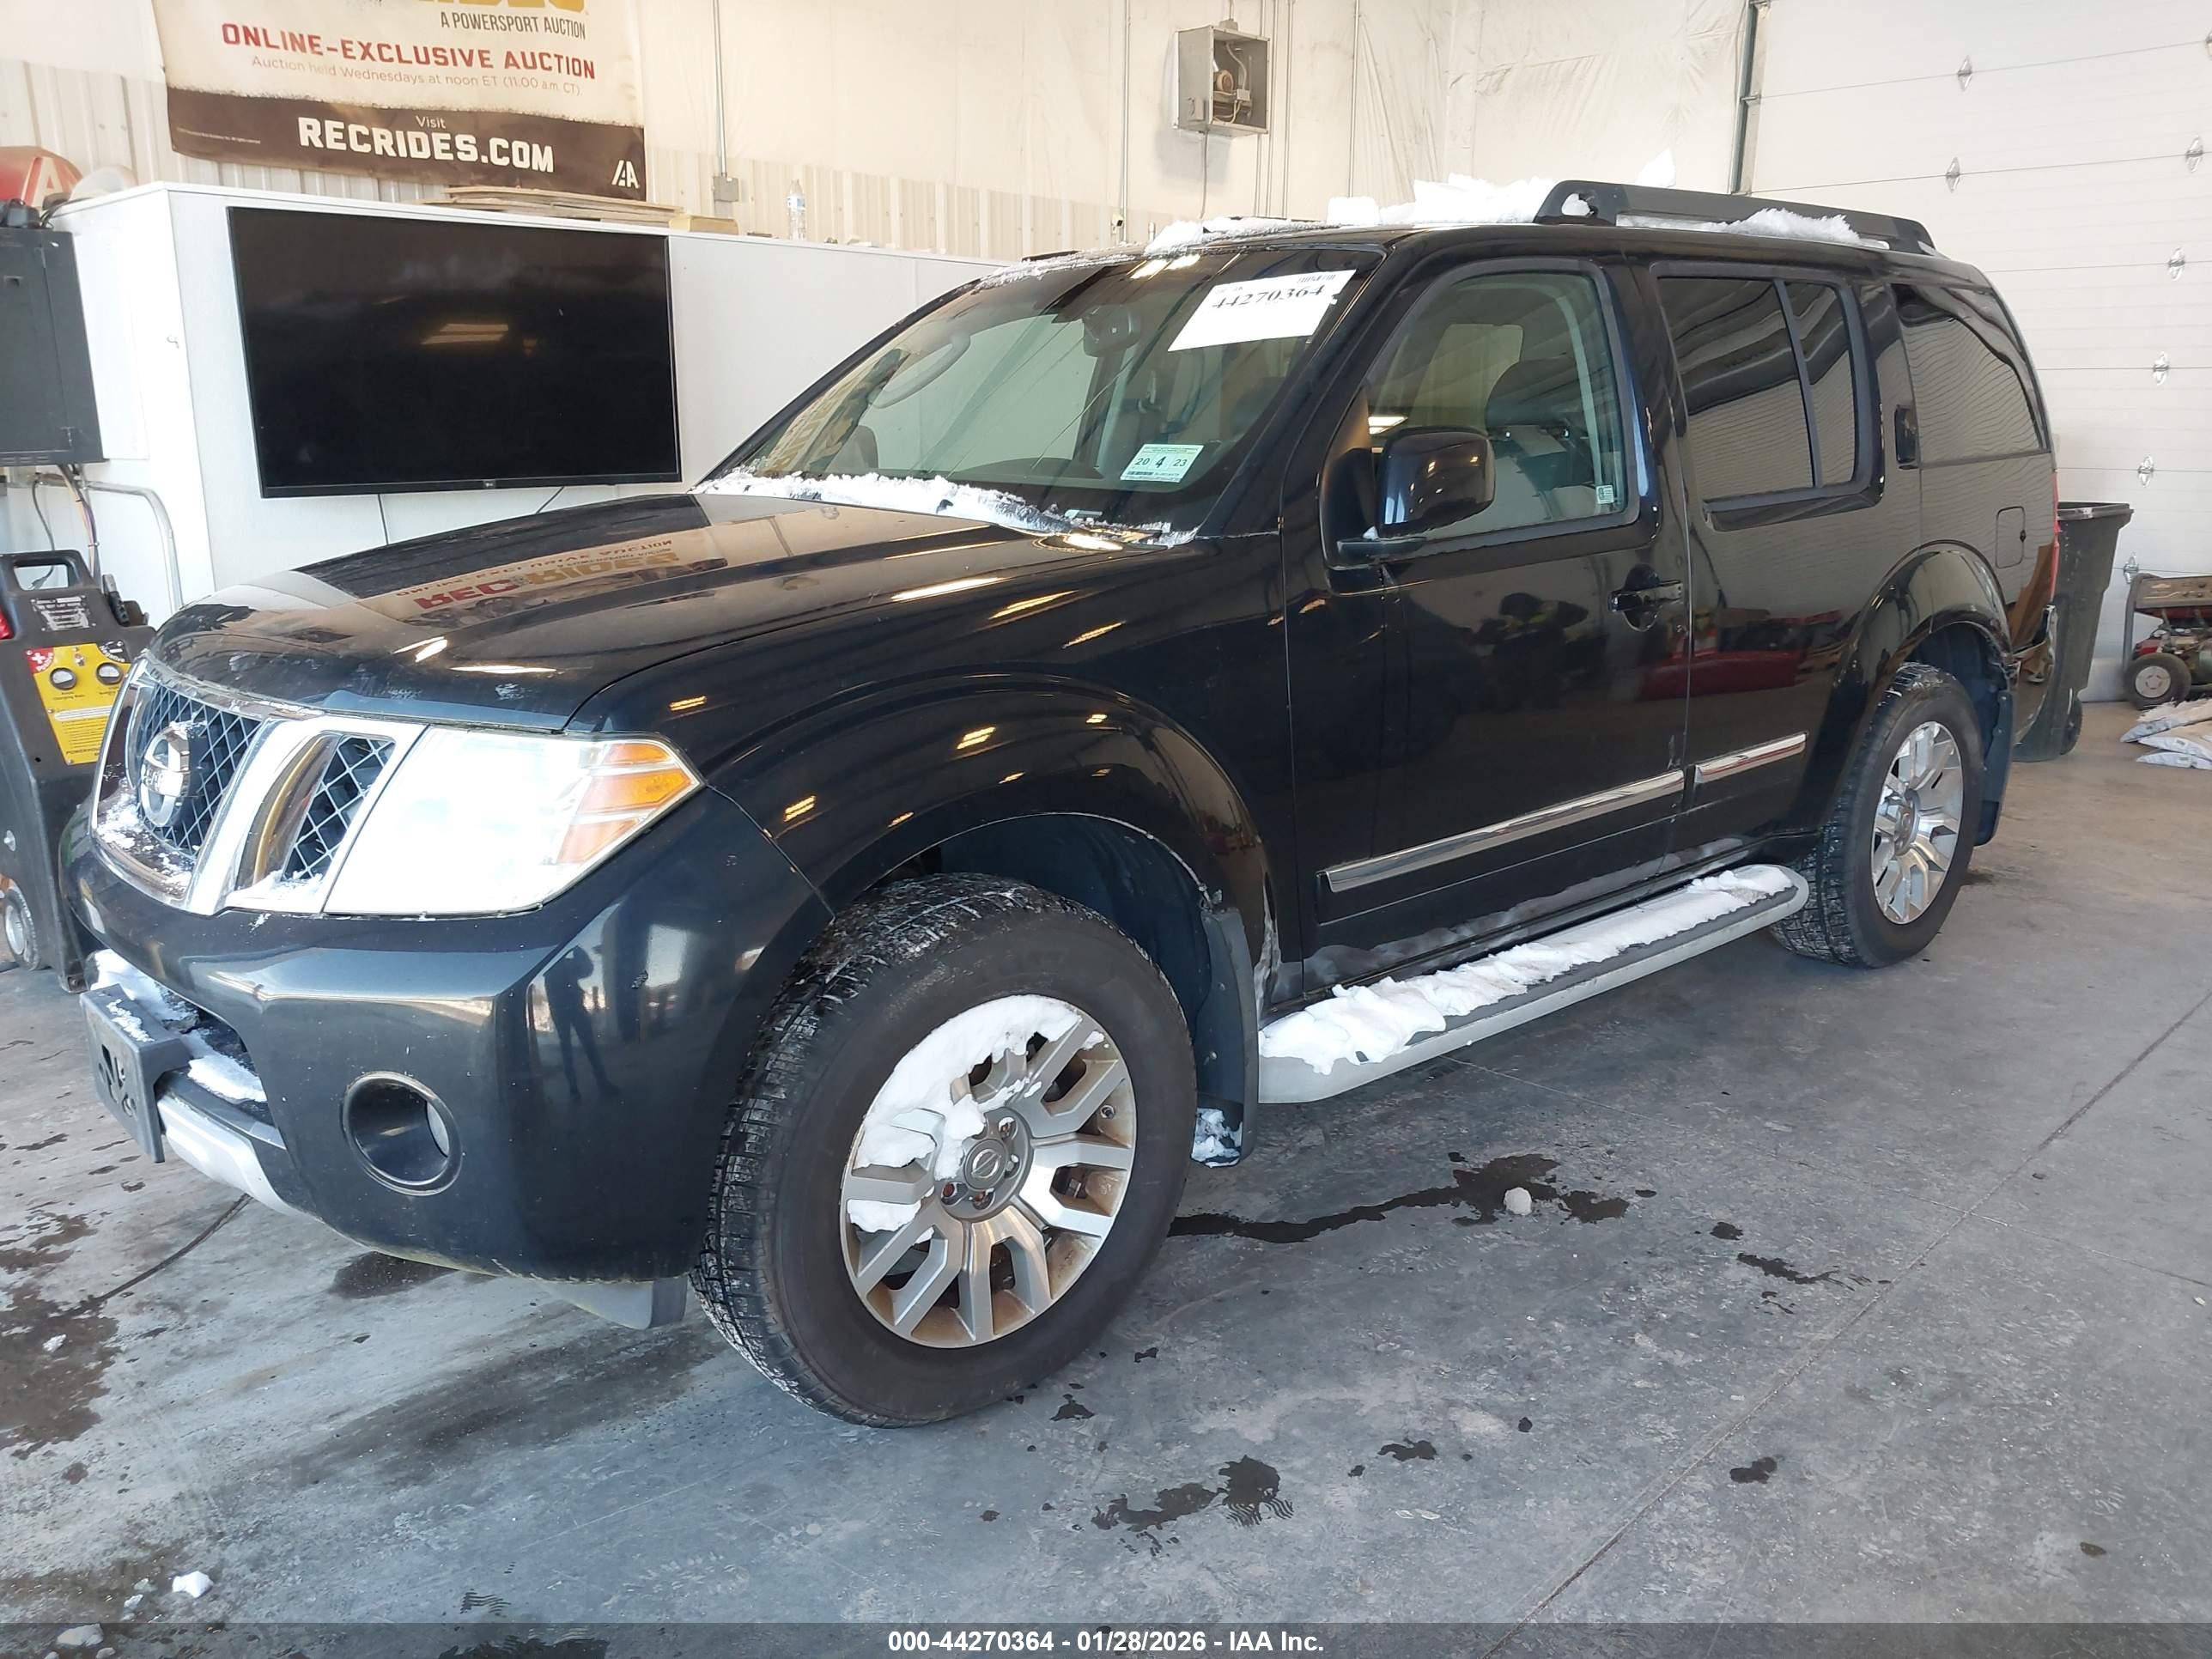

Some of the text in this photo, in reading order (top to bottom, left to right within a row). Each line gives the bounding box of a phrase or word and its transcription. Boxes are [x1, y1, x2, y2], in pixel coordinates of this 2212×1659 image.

[441, 11, 586, 40] A POWERSPORT AUCTION
[222, 23, 595, 79] ONLINE-EXCLUSIVE AUCTION
[252, 56, 306, 72] Auction
[308, 62, 336, 76] held
[341, 68, 424, 85] Wednesdays
[428, 75, 441, 84] at
[446, 76, 478, 85] noon
[482, 76, 497, 86] ET
[416, 115, 447, 130] Visit
[298, 117, 554, 173] RECRIDES.COM
[1212, 284, 1326, 309] 44270364
[1155, 456, 1167, 469] 4
[1173, 459, 1188, 467] 23
